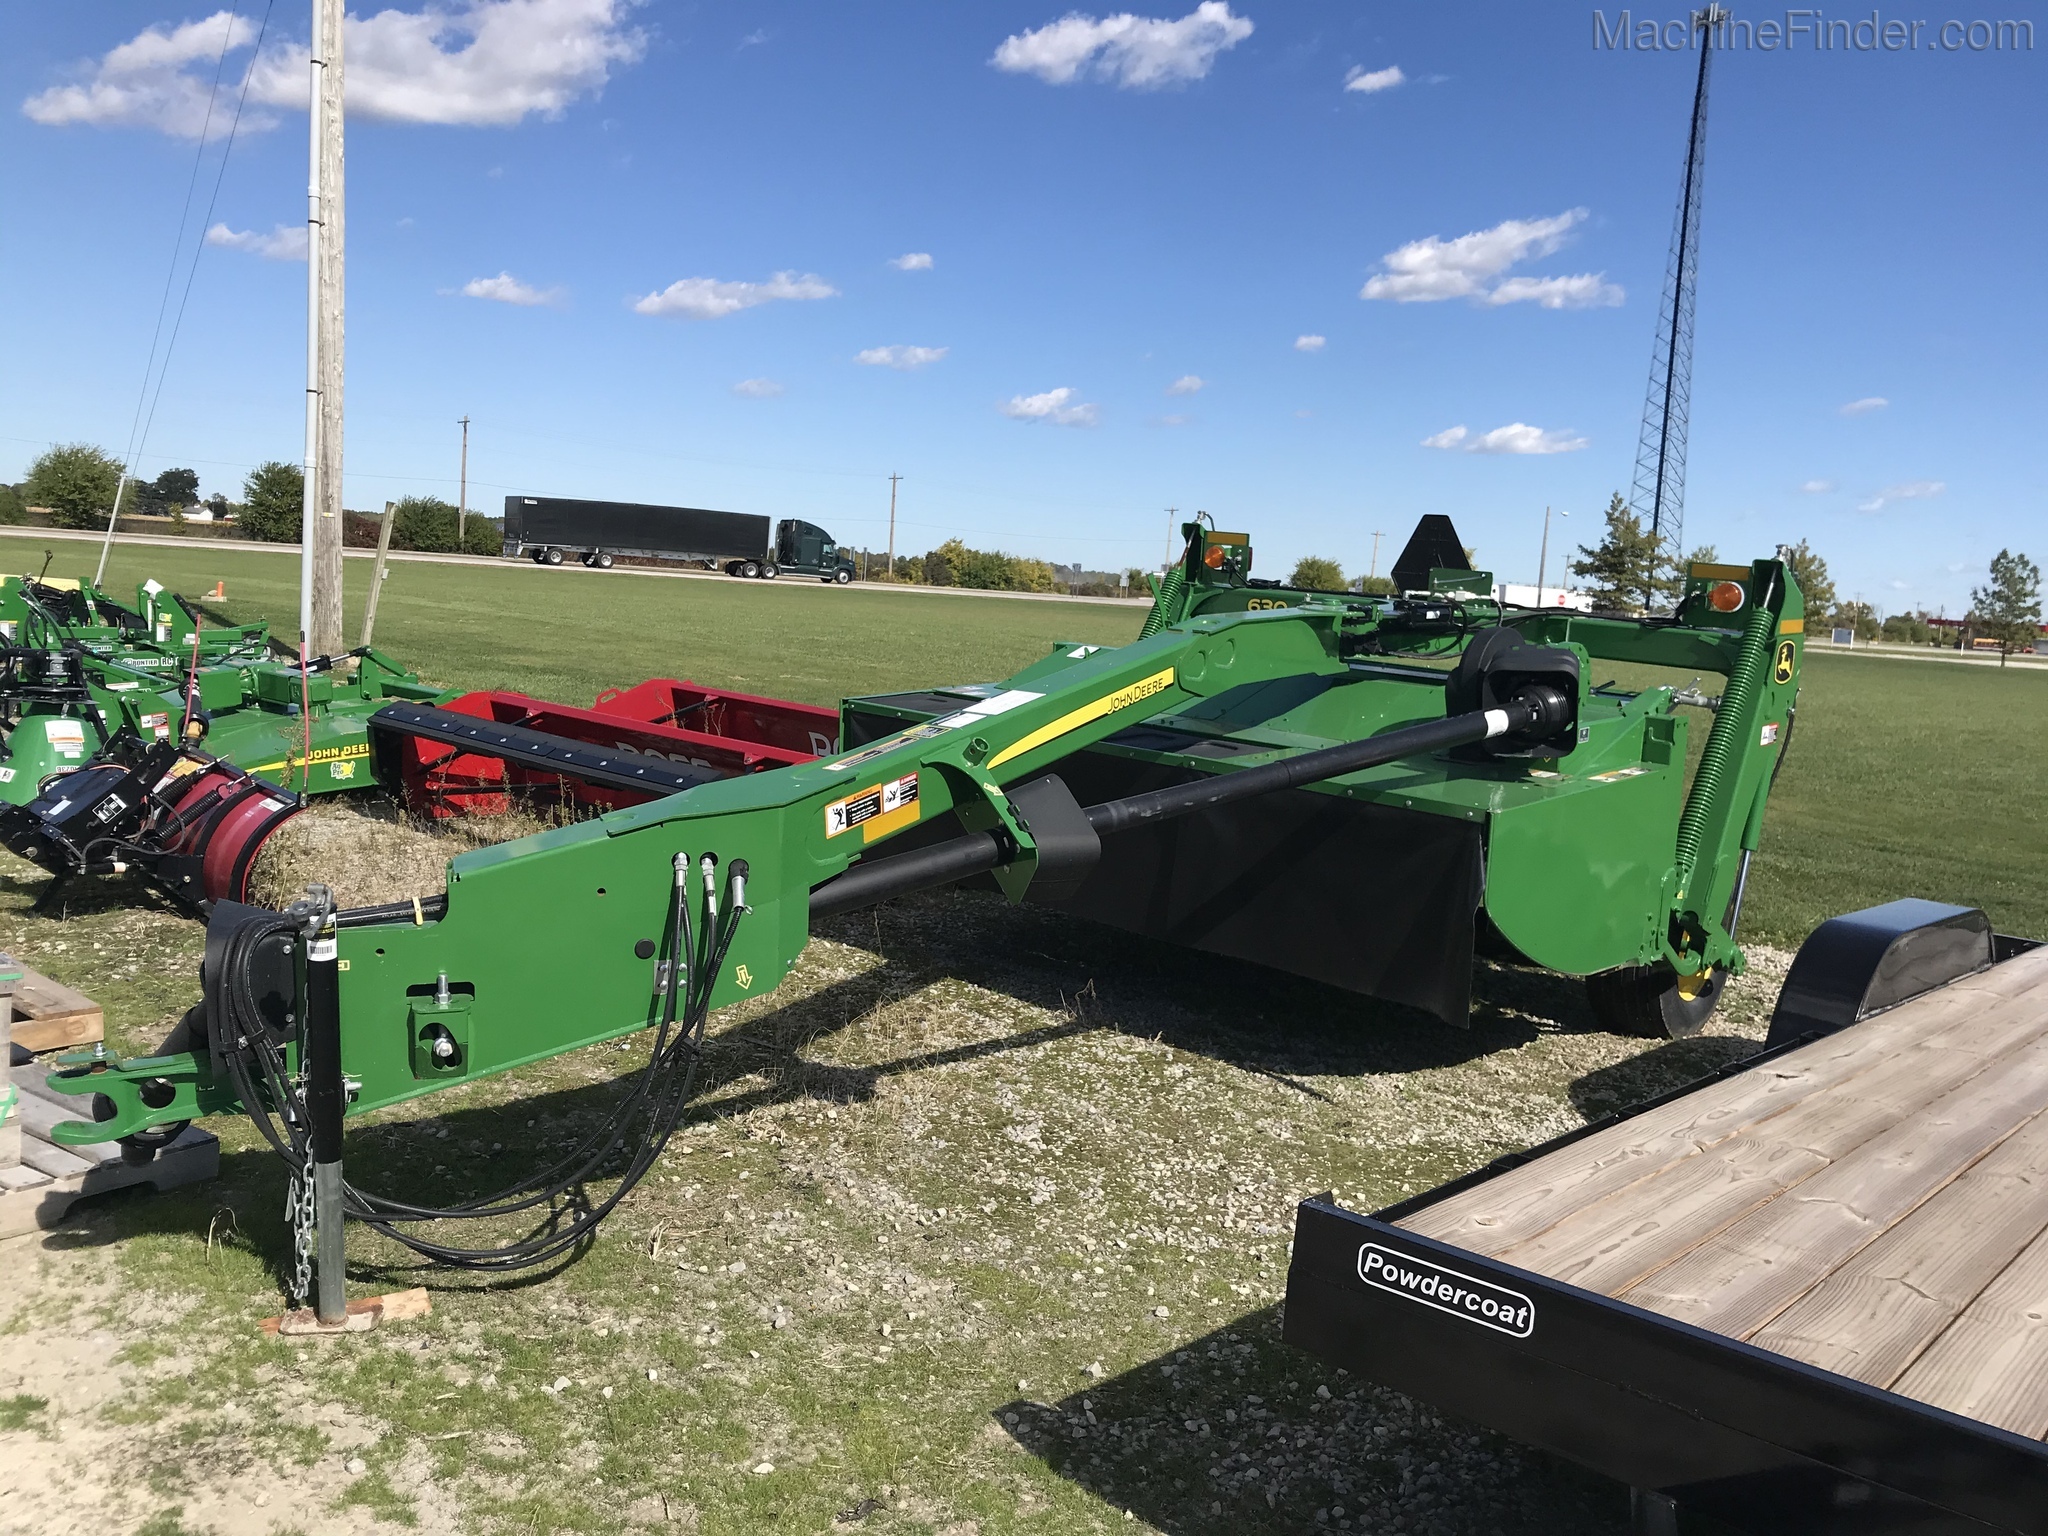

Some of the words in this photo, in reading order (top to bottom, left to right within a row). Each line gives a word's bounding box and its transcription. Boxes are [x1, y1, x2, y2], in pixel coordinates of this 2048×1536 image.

[1108, 691, 1133, 713] JOHN
[1134, 678, 1164, 701] DEERE
[308, 747, 340, 760] JOHN
[1363, 1252, 1528, 1328] Powdercoat
